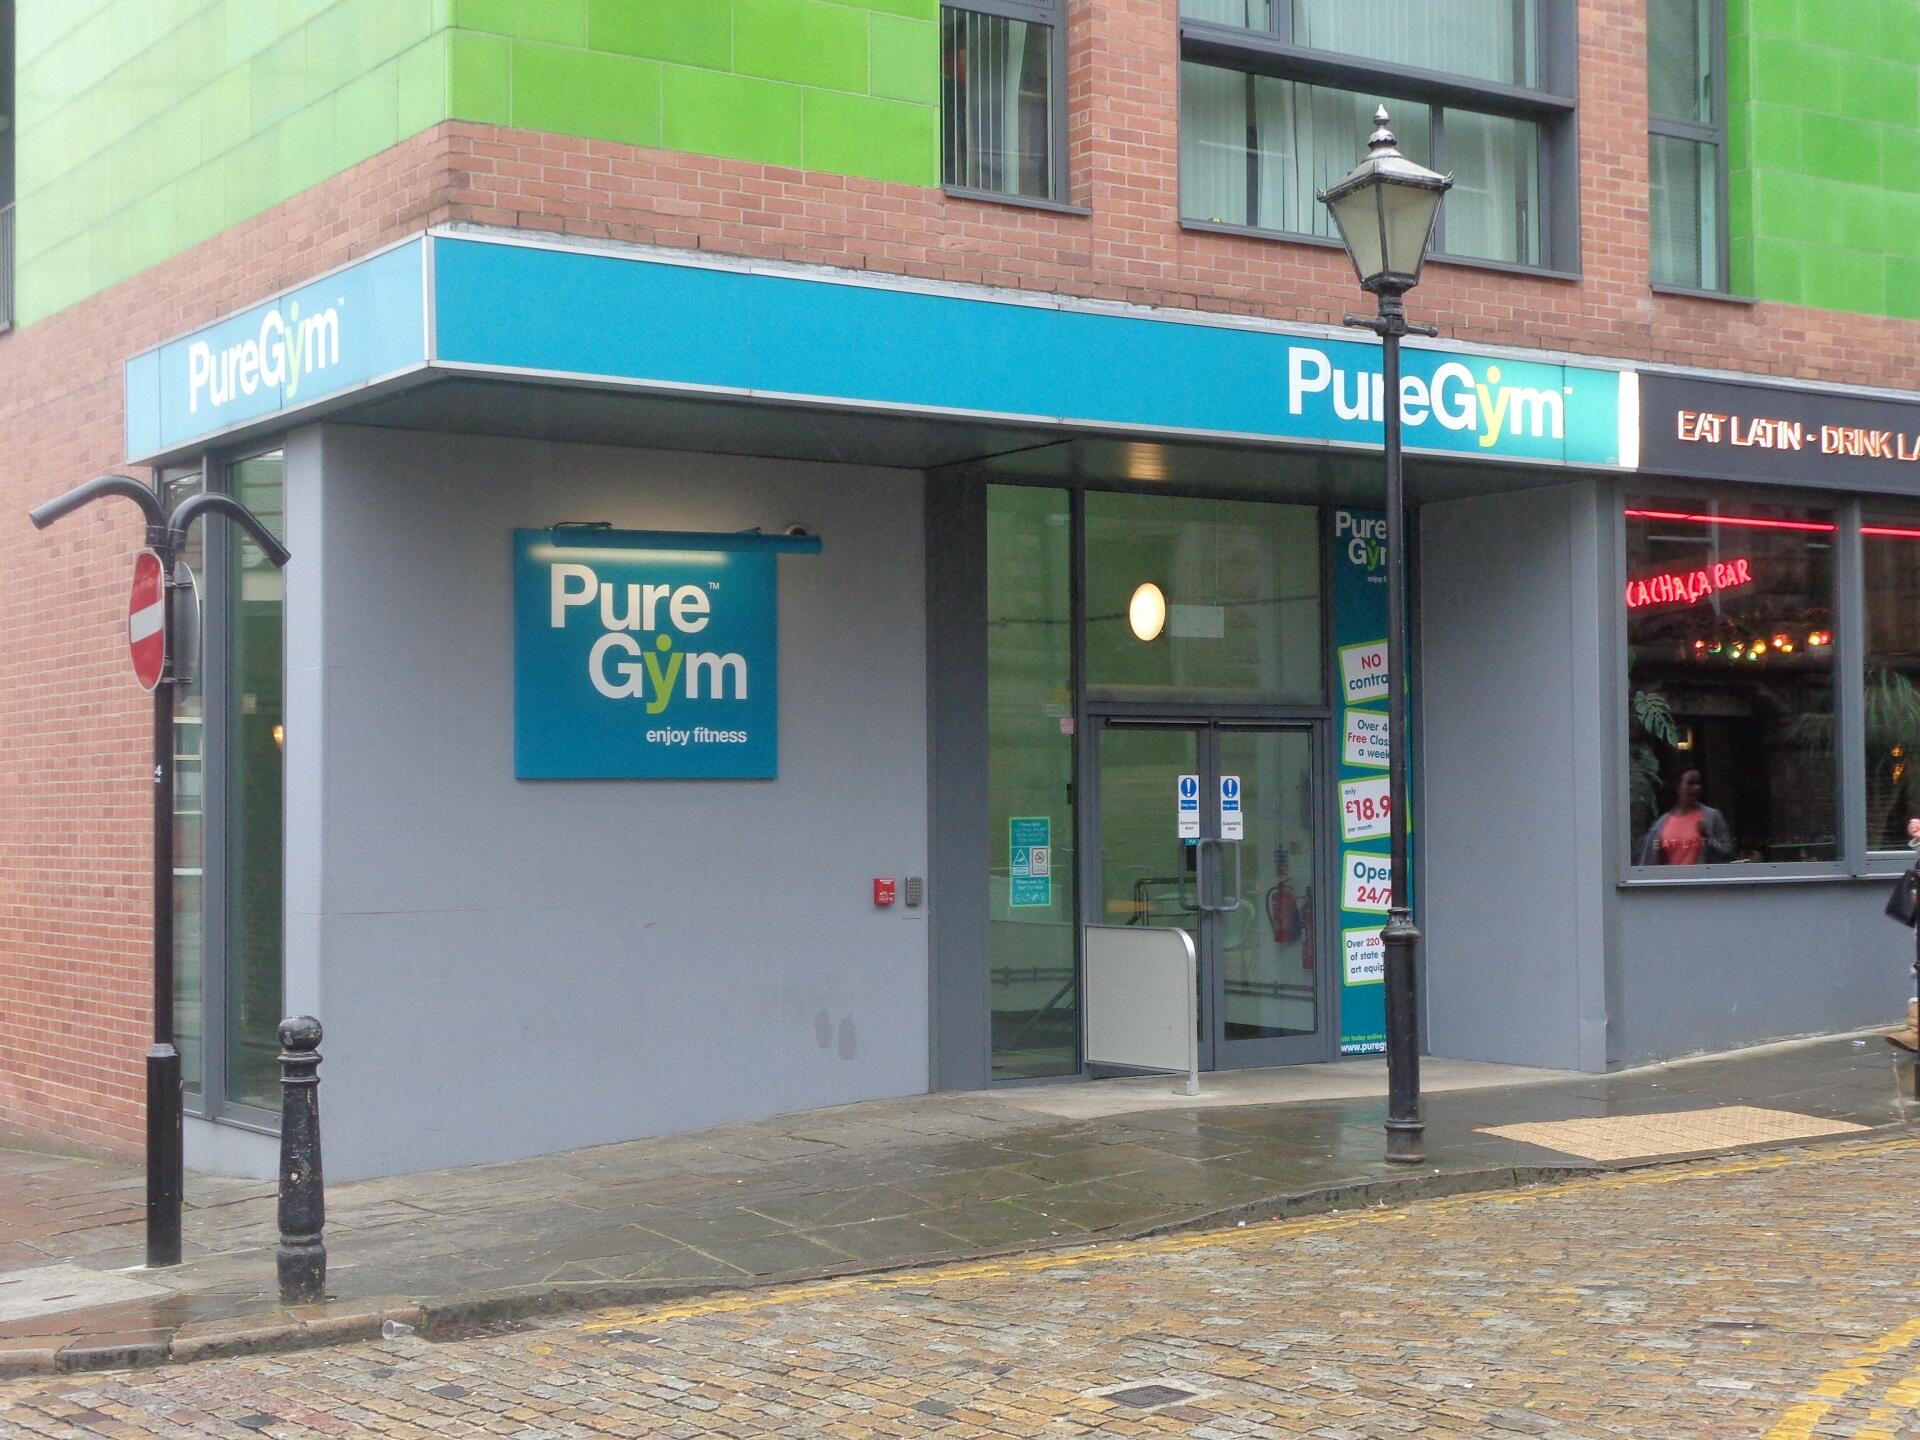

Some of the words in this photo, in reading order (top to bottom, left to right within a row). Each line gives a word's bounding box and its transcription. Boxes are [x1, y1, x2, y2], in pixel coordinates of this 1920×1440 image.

[189, 301, 340, 414] PureGym
[1678, 410, 1727, 443] EAT
[1731, 416, 1802, 450] LATIN
[1821, 425, 1893, 459] DRINK
[1335, 511, 1387, 539] Pure
[1714, 559, 1752, 589] BAR
[551, 563, 710, 633] Pure
[1361, 653, 1382, 670] NO
[589, 632, 747, 714] Gym
[1349, 673, 1391, 690] contra
[1357, 719, 1379, 731] Over
[646, 727, 690, 746] enjoy
[694, 727, 747, 743] fitness
[1347, 731, 1367, 744] Free
[1358, 748, 1365, 757] a
[1345, 795, 1392, 821] £18.9
[1357, 885, 1393, 905] 24/7
[1346, 939, 1364, 949] Over
[1366, 937, 1380, 947] 220
[1350, 951, 1358, 961] of
[1360, 951, 1379, 960] state
[1350, 965, 1361, 974] art
